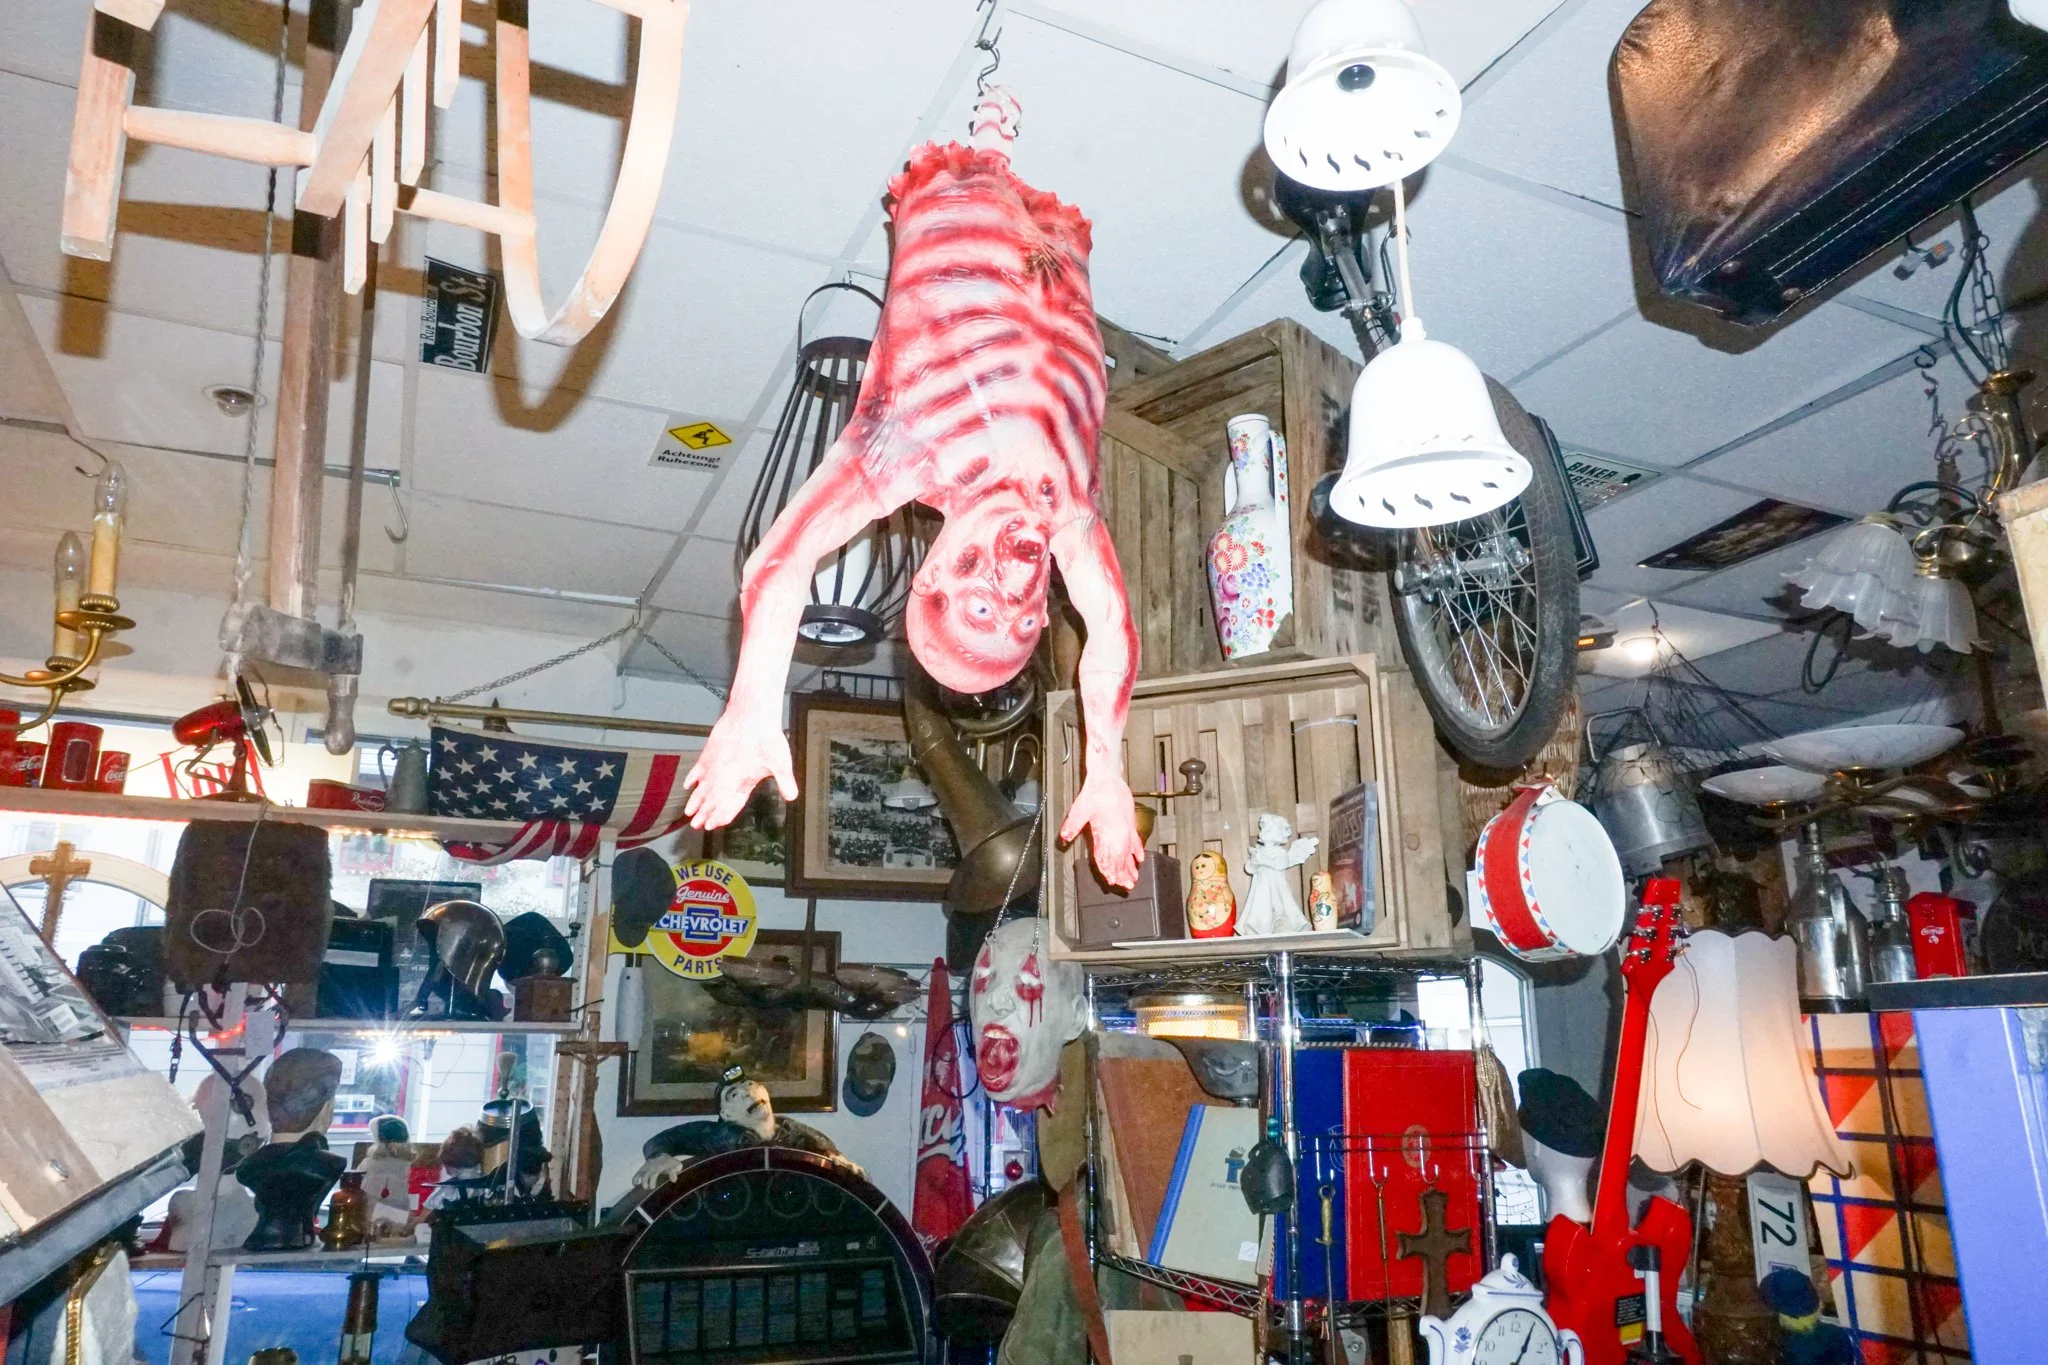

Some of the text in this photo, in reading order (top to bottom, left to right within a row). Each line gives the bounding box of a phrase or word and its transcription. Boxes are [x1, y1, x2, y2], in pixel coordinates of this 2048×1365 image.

[420, 324, 436, 341] Rue
[433, 276, 487, 372] Bourbon St.
[1567, 461, 1618, 480] BAKER
[676, 863, 733, 886] WE USE
[675, 886, 731, 904] Genuine
[658, 914, 746, 933] CHEVROLET
[673, 955, 723, 975] PARTS
[1757, 1198, 1797, 1247] 72
[1497, 1324, 1505, 1337] 11
[1509, 1320, 1521, 1334] 12
[1484, 1340, 1496, 1353] 10
